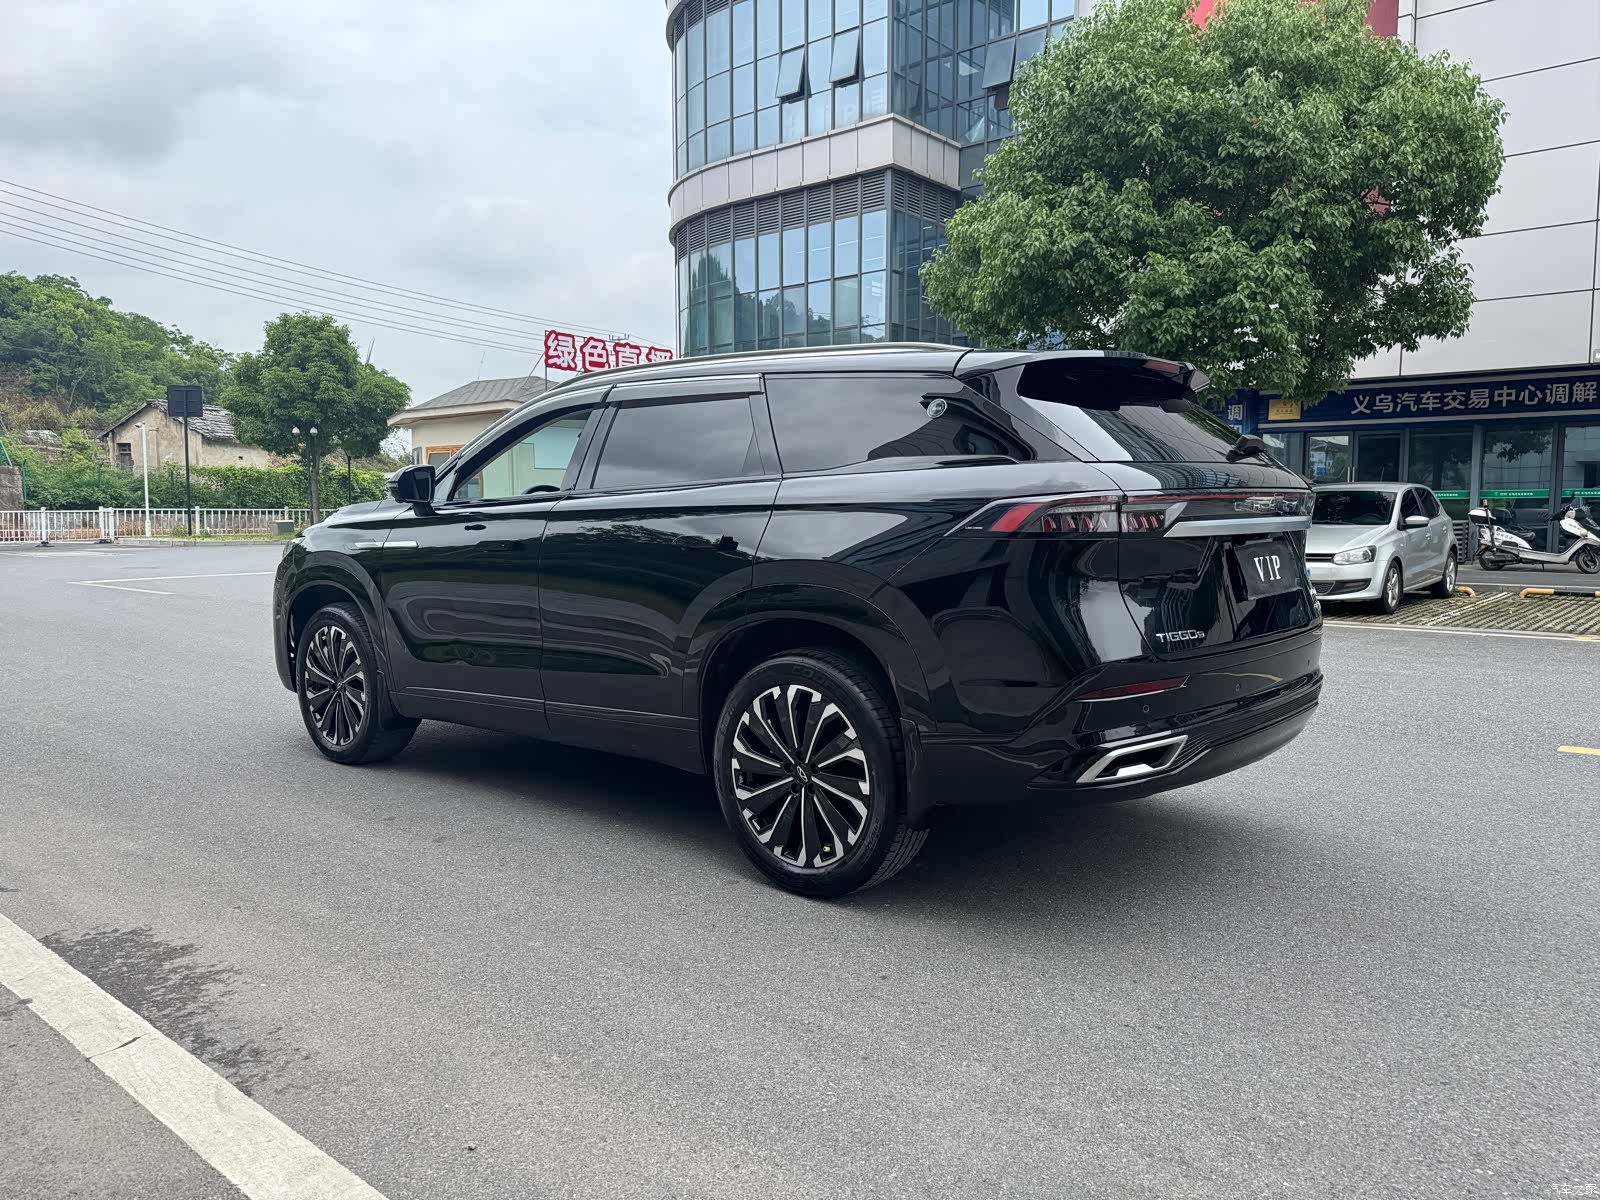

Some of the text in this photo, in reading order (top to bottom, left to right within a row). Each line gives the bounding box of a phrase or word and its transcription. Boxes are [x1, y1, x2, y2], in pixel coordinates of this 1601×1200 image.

[1350, 381, 1597, 415] 义乌汽车交易中心调解
[1253, 555, 1282, 582] VIP
